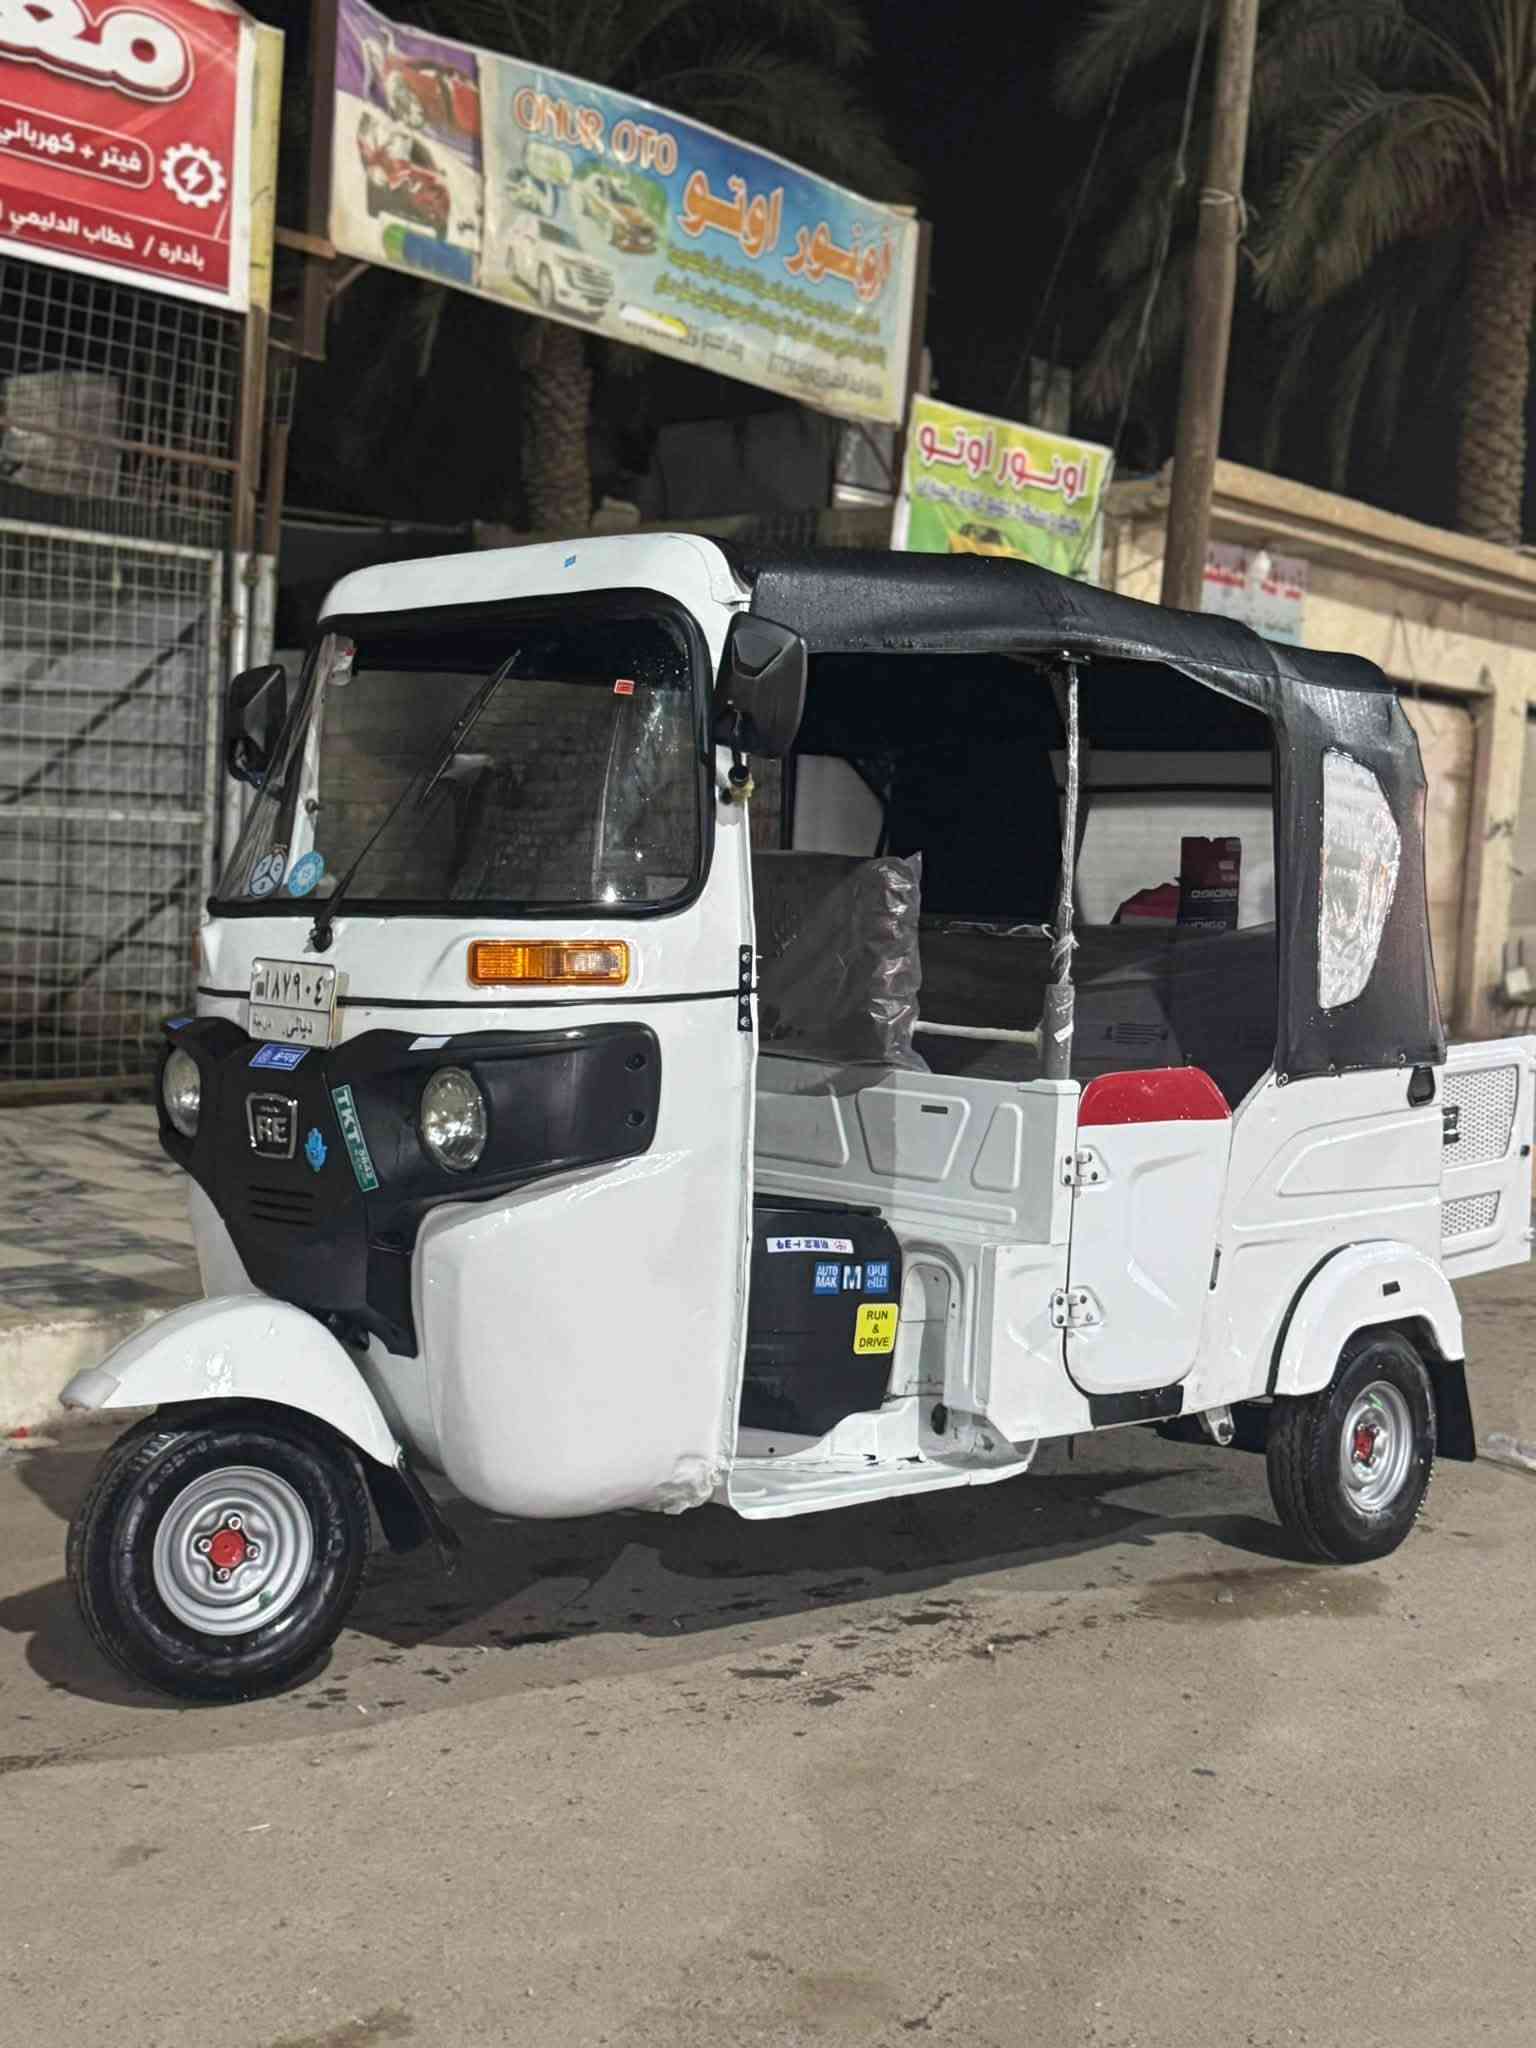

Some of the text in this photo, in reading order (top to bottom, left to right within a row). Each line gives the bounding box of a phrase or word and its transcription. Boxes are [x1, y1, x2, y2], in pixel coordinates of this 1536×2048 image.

[611, 118, 677, 176] OTO
[100, 146, 143, 174] فيتر
[83, 222, 136, 251] خطاب
[336, 1089, 361, 1144] TKT
[255, 1115, 288, 1143] RE
[816, 1264, 839, 1277] AUTO
[815, 1276, 838, 1289] MAK
[866, 1310, 888, 1321] RUN
[871, 1322, 881, 1335] &
[859, 1336, 890, 1349] DRIVE
